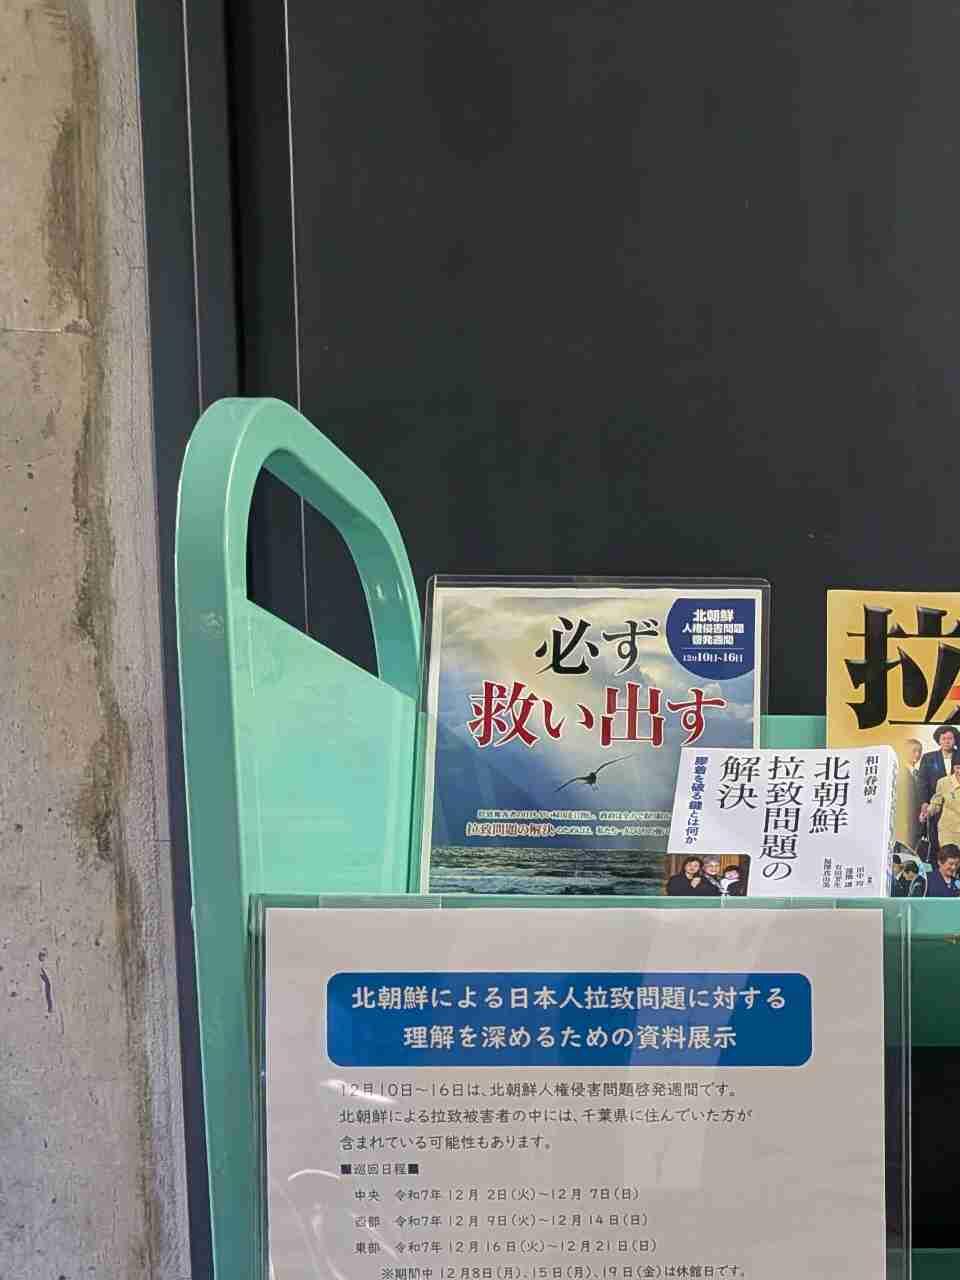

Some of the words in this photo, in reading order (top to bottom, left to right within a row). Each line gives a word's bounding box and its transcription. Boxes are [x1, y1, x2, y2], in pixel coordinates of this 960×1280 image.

[692, 607, 735, 622] 北朝鮮
[535, 615, 660, 677] 必ず
[467, 679, 728, 747] 救い出す
[717, 755, 761, 810] 解決
[808, 755, 850, 835] 北朝鮮
[759, 755, 804, 881] 拉致問題の
[351, 984, 787, 1011] 北朝鮮による日本人拉致問題に対する
[402, 1024, 738, 1050] 理解を深めるための資料展示
[339, 1108, 753, 1124] 北朝鮮による拉致被害者の中には、千葉県に住んでいた方が
[338, 1135, 552, 1151] 含まれている可能性もあります。
[354, 1189, 381, 1202] 中央
[354, 1241, 381, 1255] 東部
